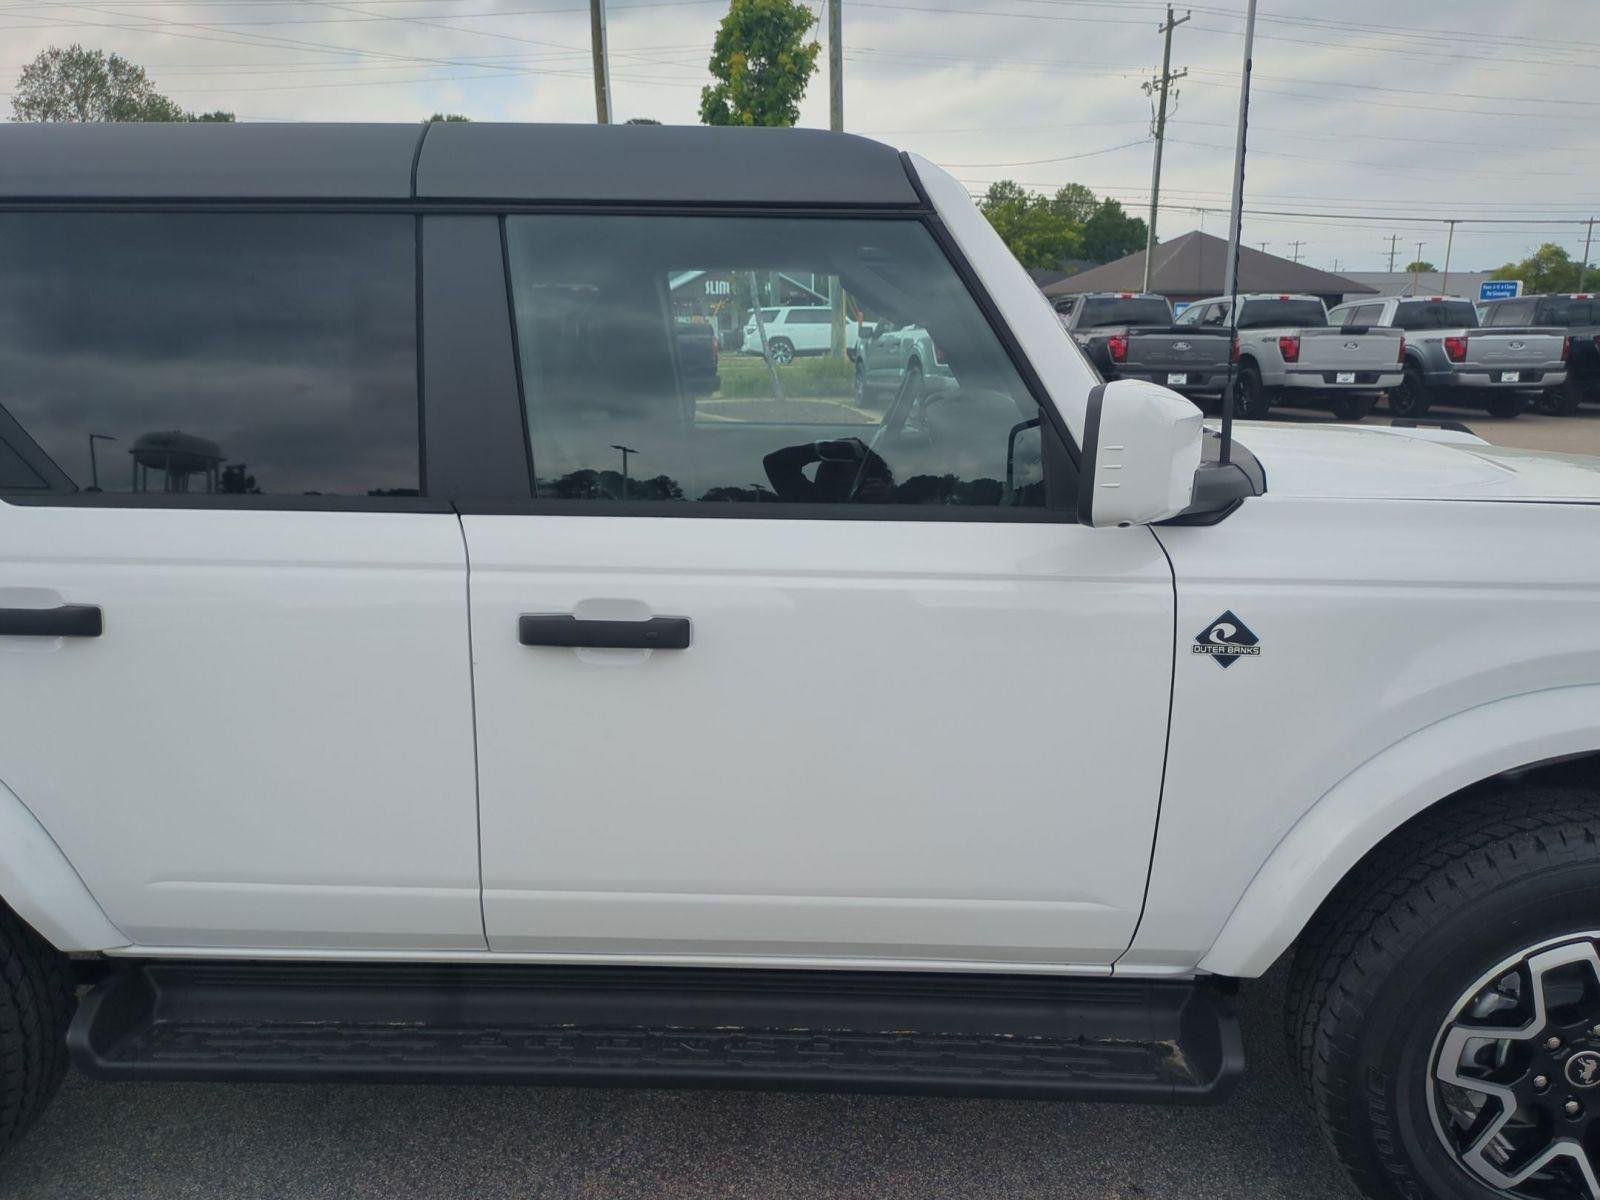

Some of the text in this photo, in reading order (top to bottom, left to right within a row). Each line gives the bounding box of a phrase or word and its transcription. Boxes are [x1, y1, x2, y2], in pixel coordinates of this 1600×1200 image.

[705, 280, 730, 295] SLIM
[1194, 645, 1260, 655] OUTER BANKS
